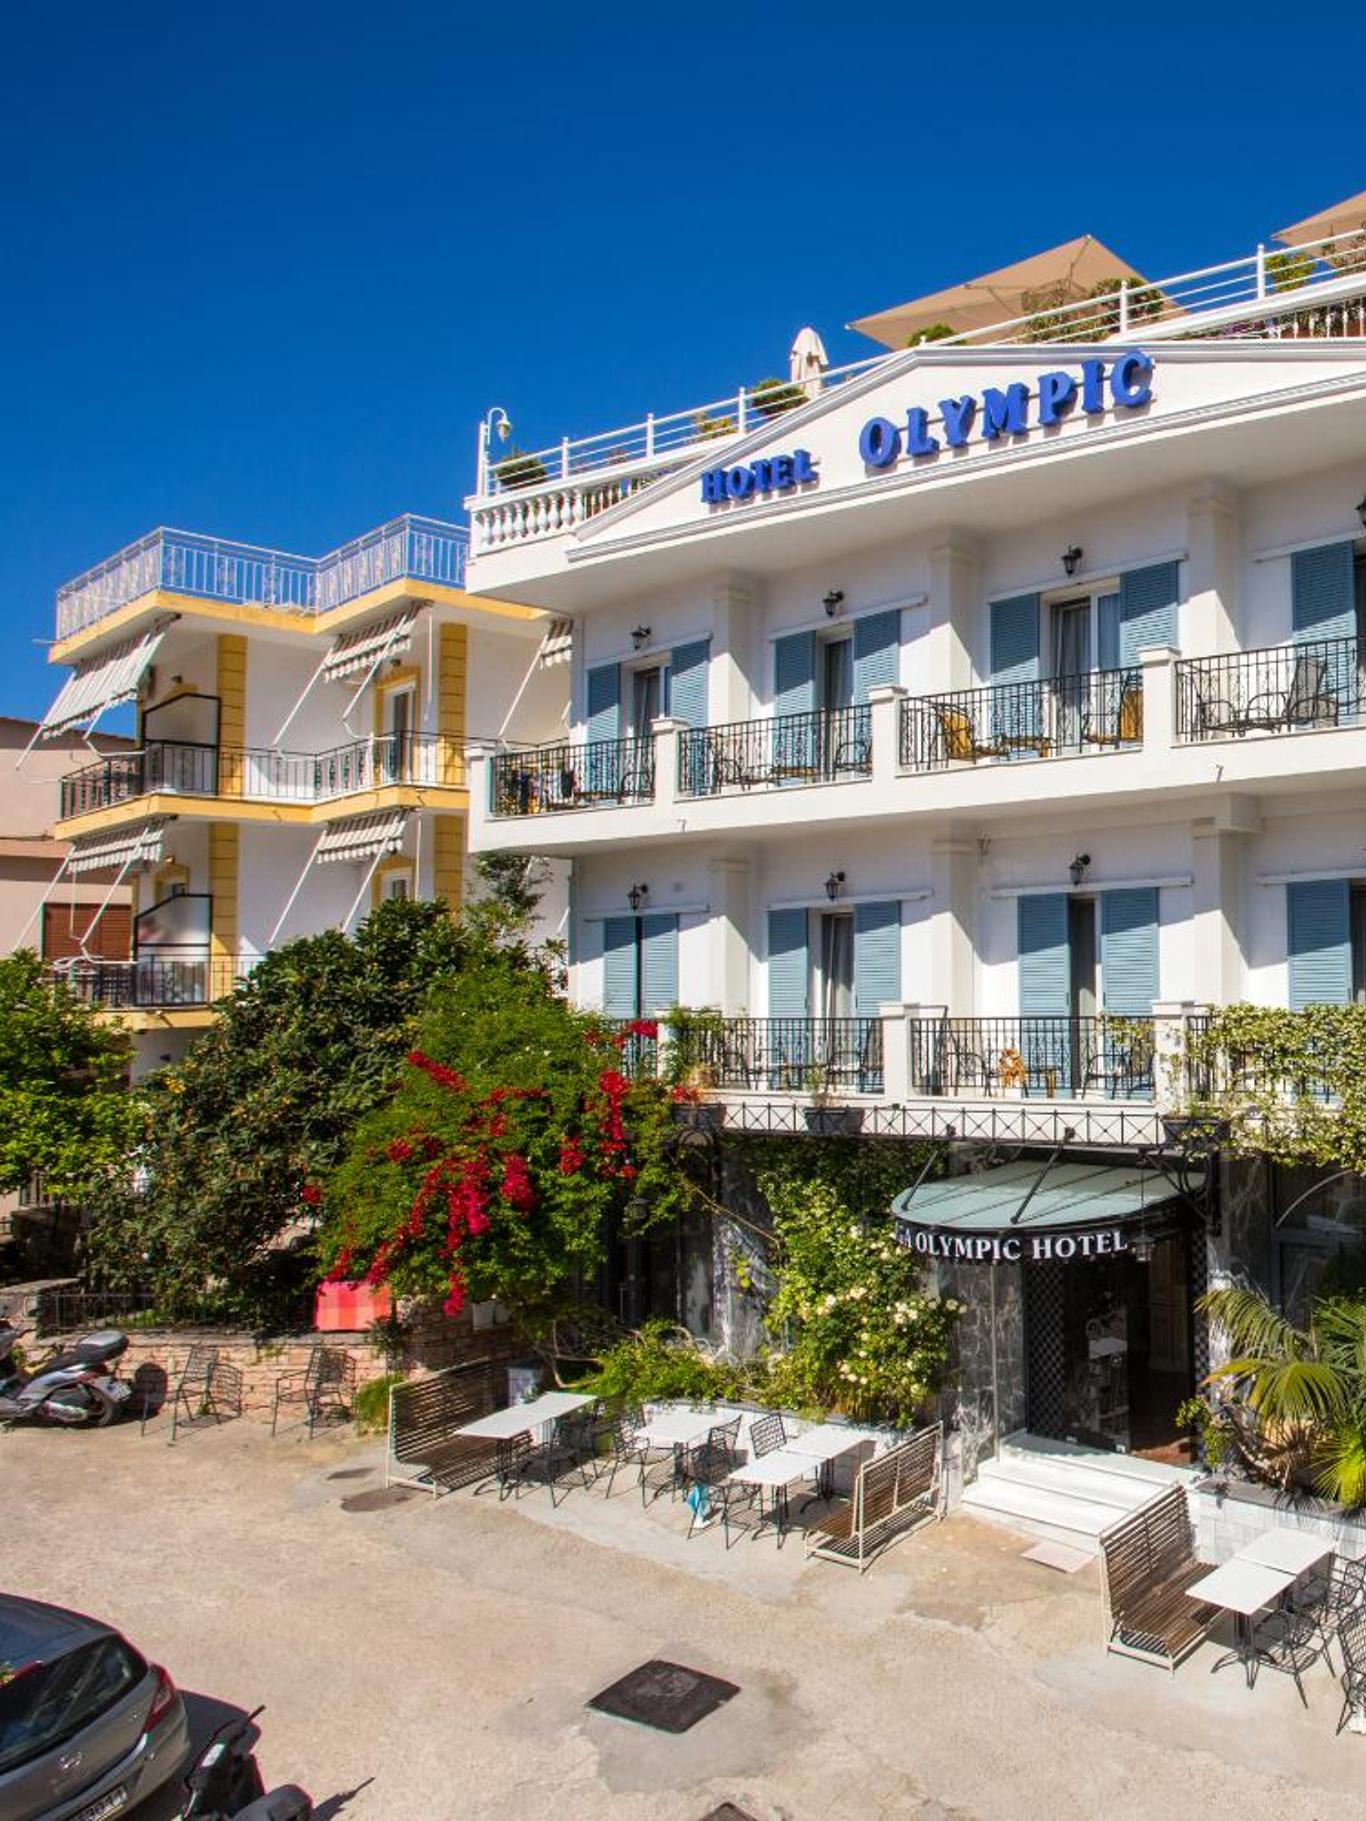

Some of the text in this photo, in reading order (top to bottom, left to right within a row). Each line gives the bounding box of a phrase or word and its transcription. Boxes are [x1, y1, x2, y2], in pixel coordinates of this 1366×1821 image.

[700, 350, 1155, 504] HOTEL OLYMPIC
[915, 1232, 1021, 1260] OLYMPIC
[1033, 1231, 1128, 1260] HOTEL
